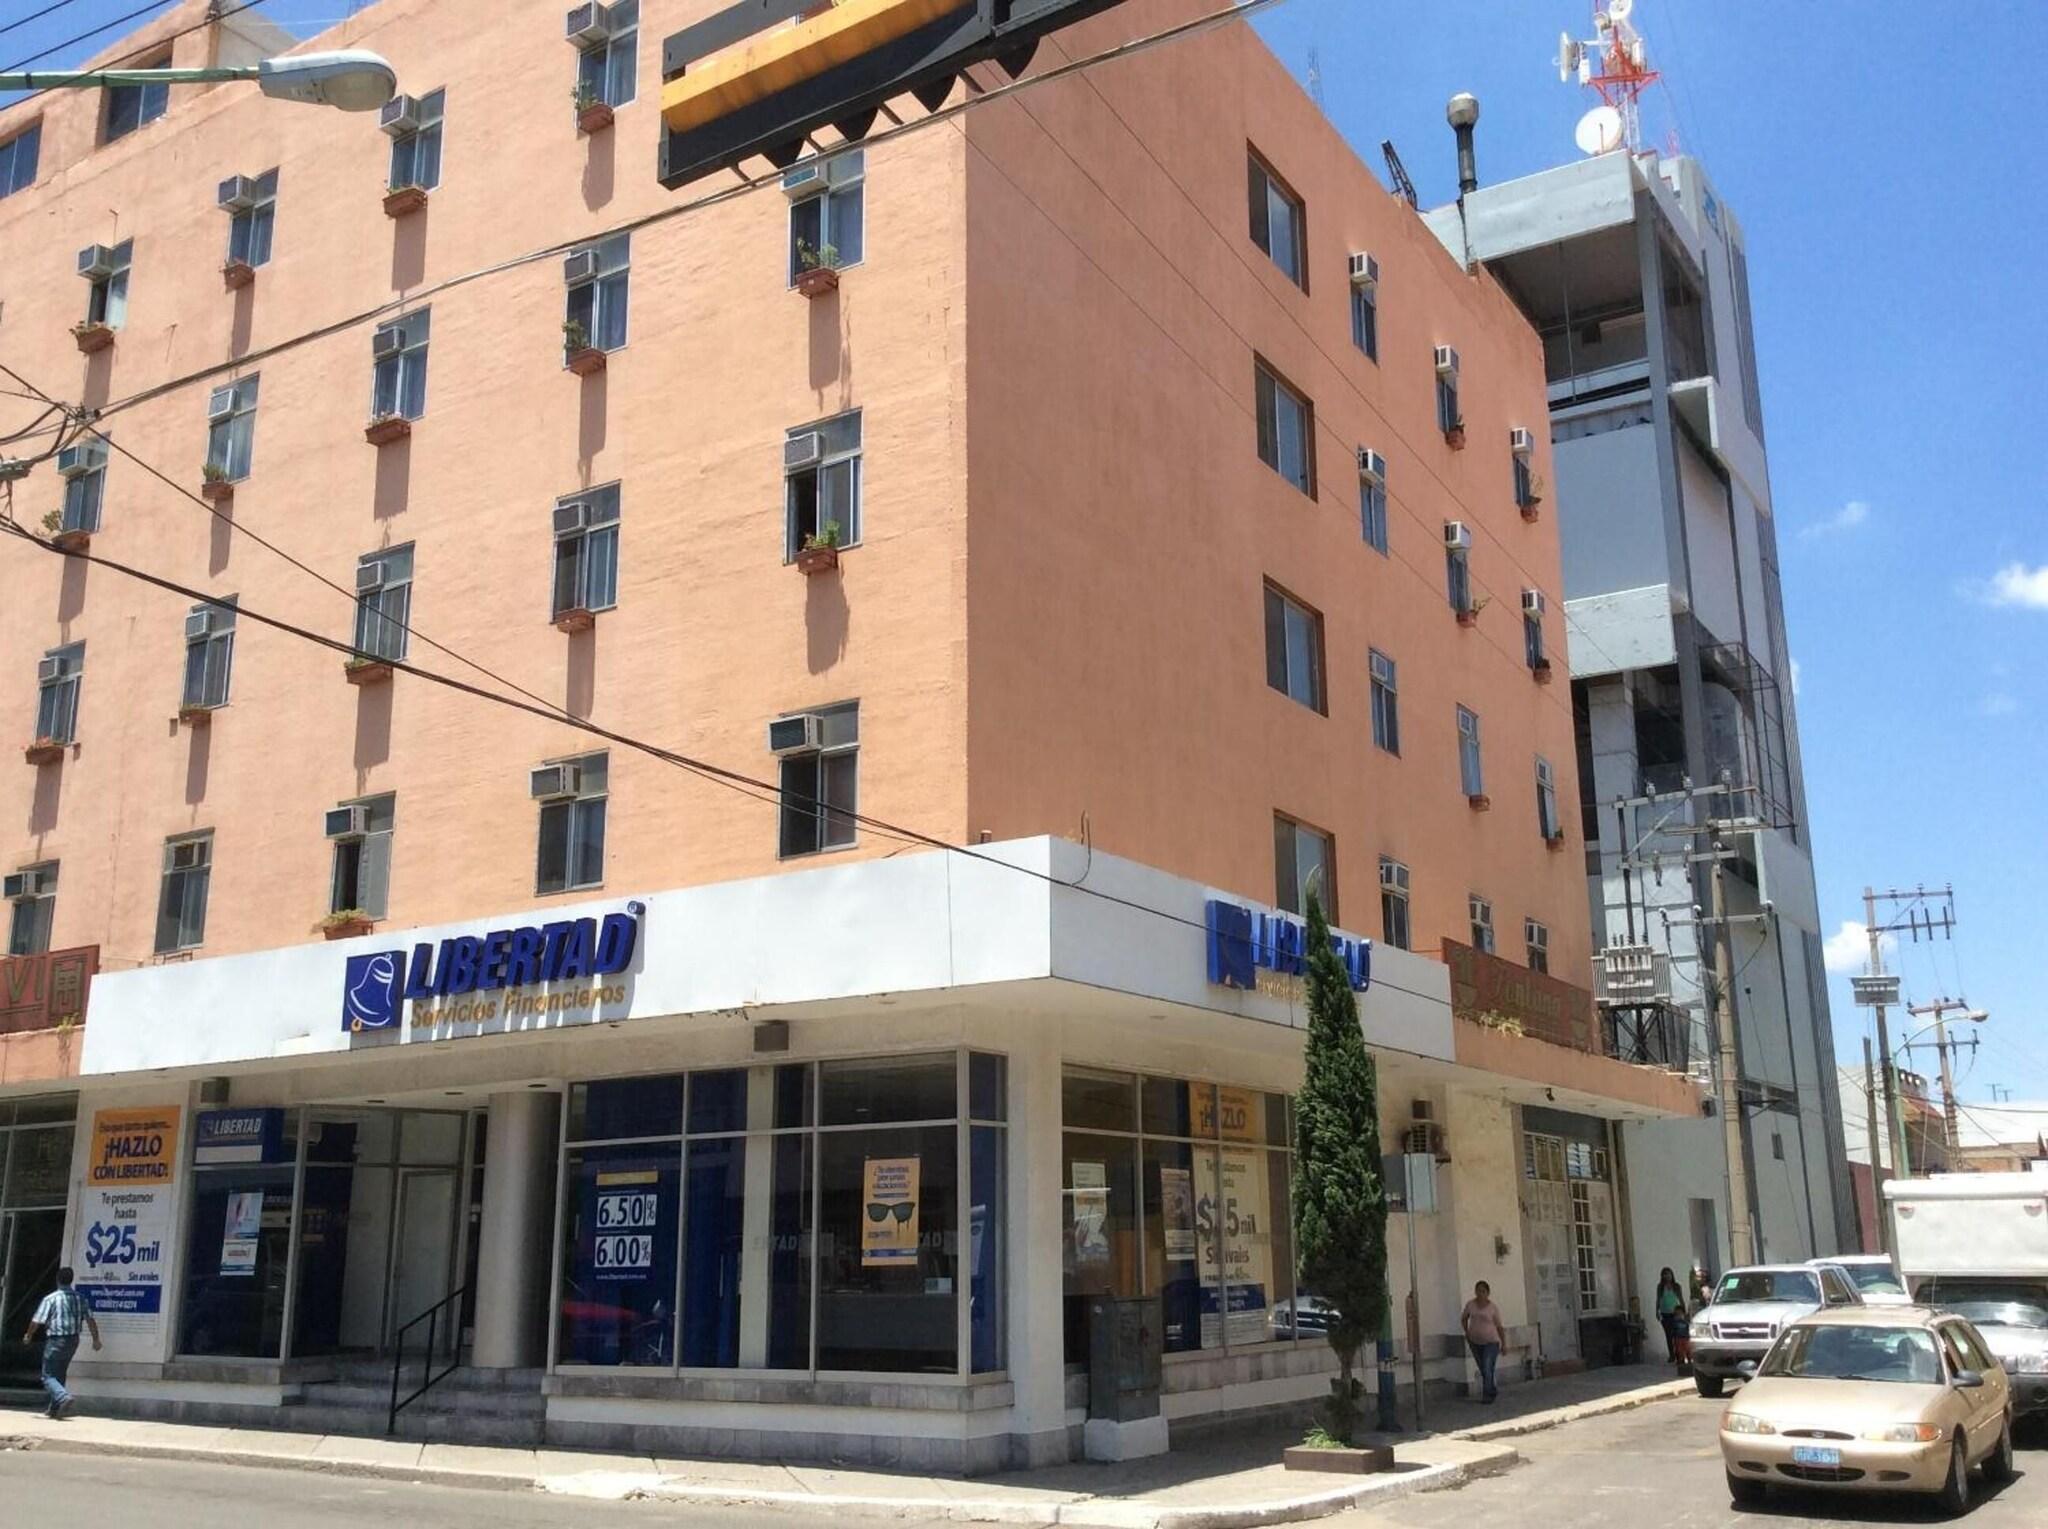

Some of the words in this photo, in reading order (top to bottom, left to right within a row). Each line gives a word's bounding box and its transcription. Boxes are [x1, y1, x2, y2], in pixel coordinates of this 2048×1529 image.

[405, 912, 637, 1000] LIBERTAD
[410, 1001, 497, 1029] Servicios
[503, 985, 626, 1017] Financieros
[213, 1117, 263, 1136] LIBERTAD
[1200, 1103, 1247, 1132] ¡HZLO
[103, 1134, 163, 1165] ¡HAZLO
[94, 1165, 116, 1180] CON
[117, 1162, 169, 1179] LIBERTAD!
[102, 1192, 110, 1204] Te
[111, 1192, 154, 1207] prestamos
[114, 1206, 137, 1219] hasta
[599, 1196, 655, 1225] 6.50%
[86, 1221, 137, 1268] $25
[137, 1240, 160, 1262] mil
[596, 1237, 651, 1266] 6.00%
